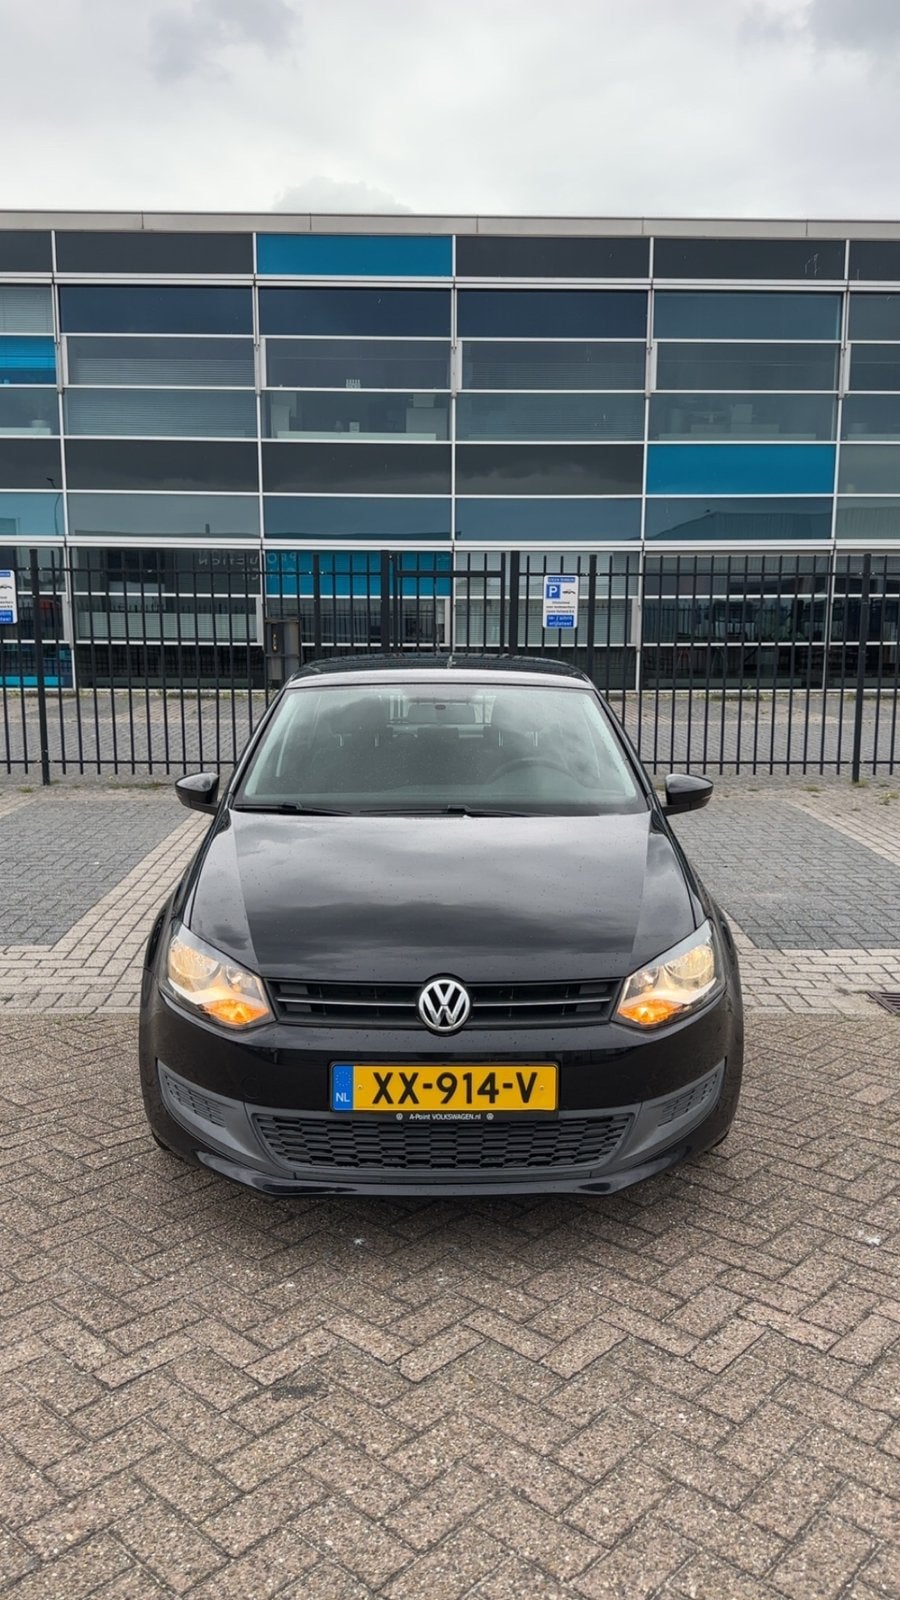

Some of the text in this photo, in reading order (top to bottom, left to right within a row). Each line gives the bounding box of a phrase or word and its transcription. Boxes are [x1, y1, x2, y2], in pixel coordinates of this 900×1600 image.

[549, 586, 557, 597] P
[372, 1072, 538, 1105] XX-914-V
[335, 1092, 350, 1103] NL
